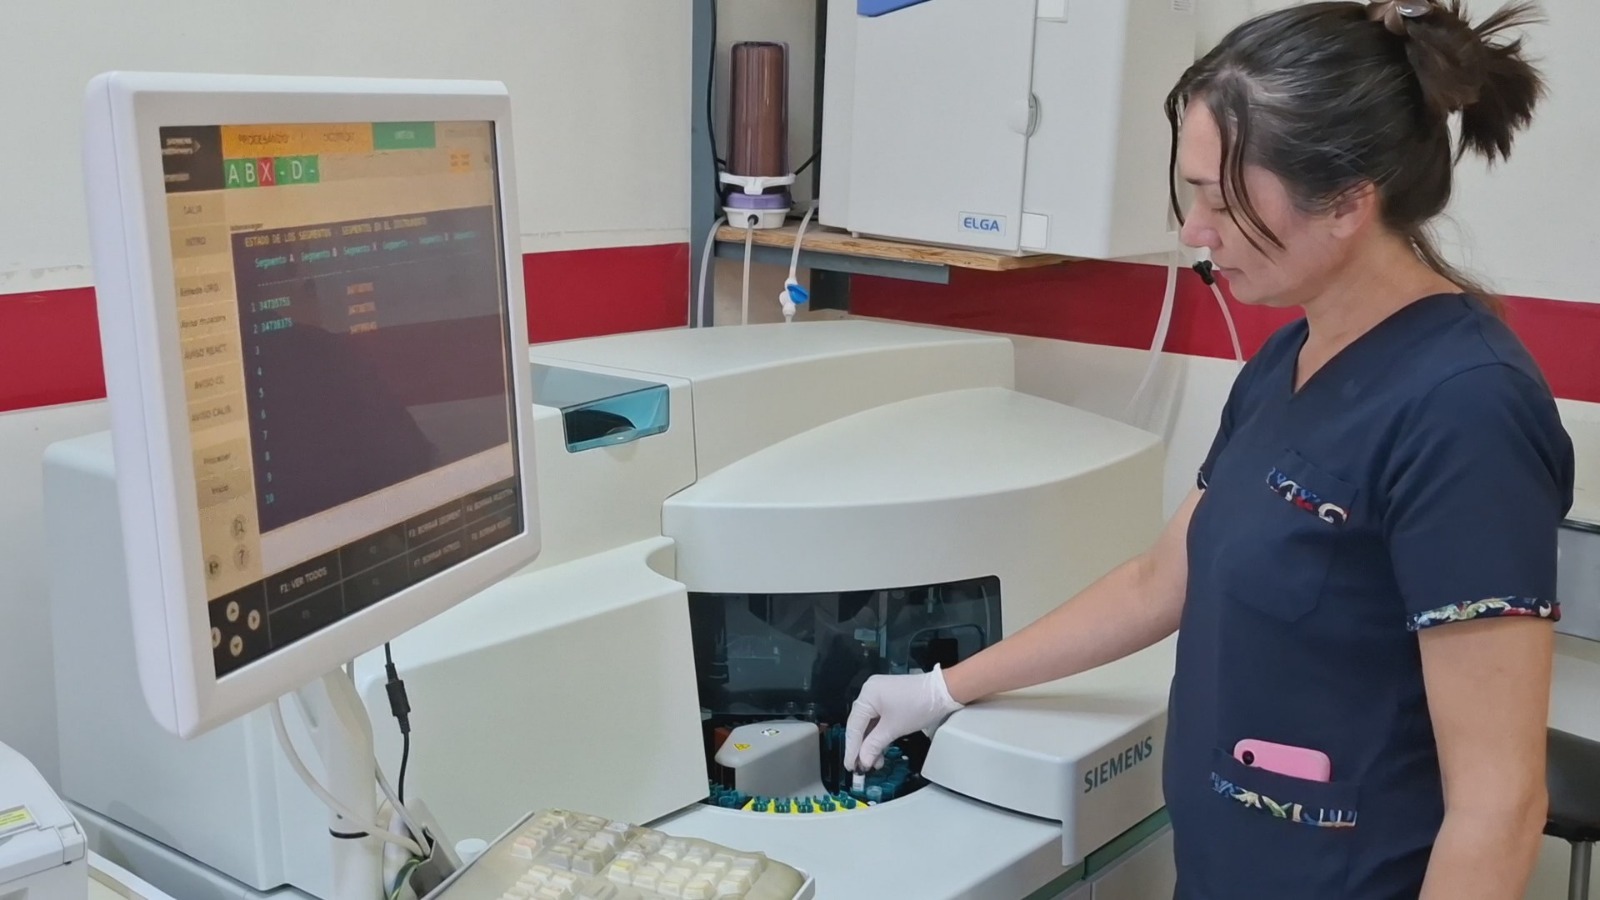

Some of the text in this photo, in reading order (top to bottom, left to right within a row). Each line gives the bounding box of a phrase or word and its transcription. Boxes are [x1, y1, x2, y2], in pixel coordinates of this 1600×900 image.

[228, 163, 240, 184] A
[245, 162, 255, 183] B
[260, 162, 272, 182] X
[291, 160, 303, 180] D
[963, 216, 1000, 232] ELGA
[245, 235, 270, 247] ESTADO
[272, 233, 282, 244] DE
[285, 232, 297, 242] LOS
[255, 256, 287, 269] Segmento
[265, 493, 275, 505] 10
[291, 576, 304, 589] VER
[305, 566, 329, 583] TODOS
[1084, 735, 1152, 794] SIEMENS
